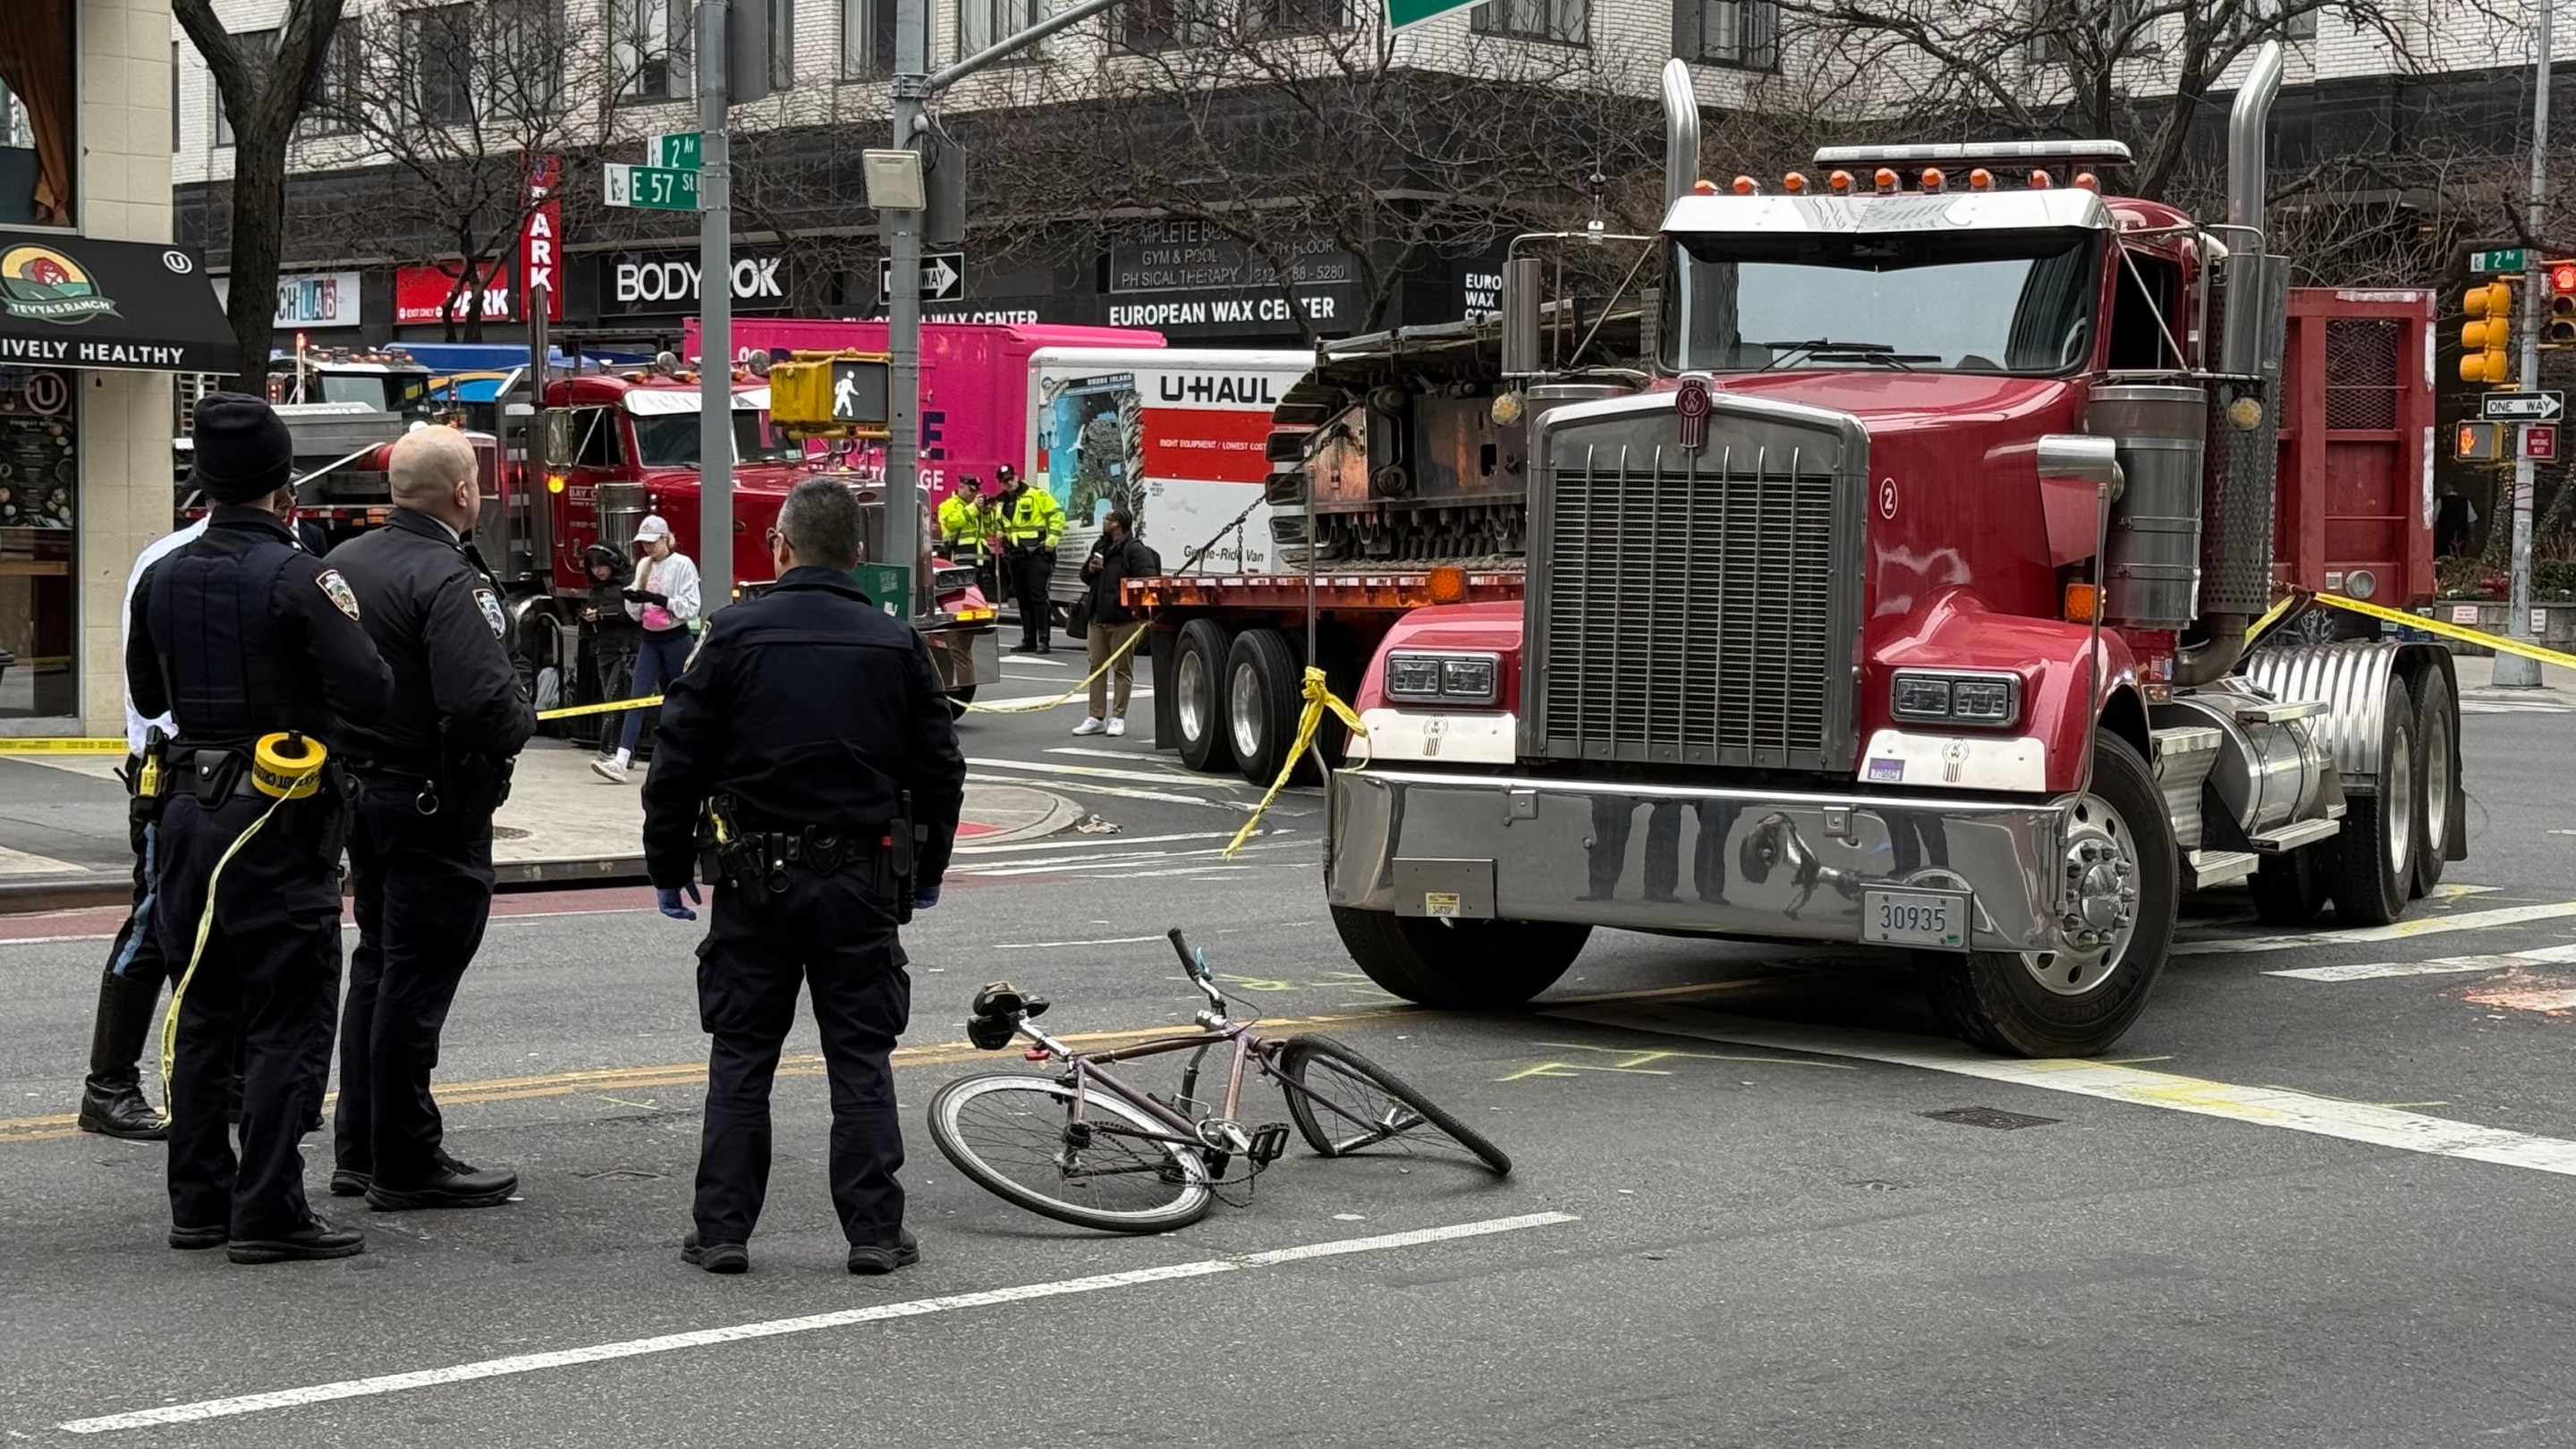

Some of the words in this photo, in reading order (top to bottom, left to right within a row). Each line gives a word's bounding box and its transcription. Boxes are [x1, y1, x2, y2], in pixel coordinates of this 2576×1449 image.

[672, 140, 680, 168] 2
[684, 136, 694, 154] Av
[631, 172, 642, 201] E
[651, 174, 674, 203] 57
[682, 173, 694, 191] St
[1293, 238, 1335, 255] FLOOR
[1142, 250, 1170, 266] GYM
[1173, 249, 1182, 264] &
[1184, 247, 1218, 263] POOL
[2494, 251, 2502, 268] 2
[2505, 250, 2515, 261] Av
[617, 258, 783, 301] BODYOK
[921, 270, 945, 286] WAY
[1179, 267, 1239, 284] THERAPY
[1317, 265, 1344, 280] 5280
[12, 302, 63, 315] TEVYA'S
[64, 300, 110, 312] RANCH
[301, 280, 337, 320] LAB
[1465, 291, 1496, 308] WAX
[1110, 301, 1206, 326] EUROPEAN
[1211, 300, 1254, 323] WAX
[2, 338, 68, 360] IVELY
[80, 343, 184, 365] HEALTHY
[1161, 376, 1276, 404] U-HAUL
[2489, 401, 2513, 412] ONE
[2526, 400, 2551, 411] WAY
[1223, 442, 1248, 451] LOWEST
[1885, 487, 1893, 510] 2
[1246, 548, 1264, 563] Van
[1880, 904, 1945, 932] 30935
